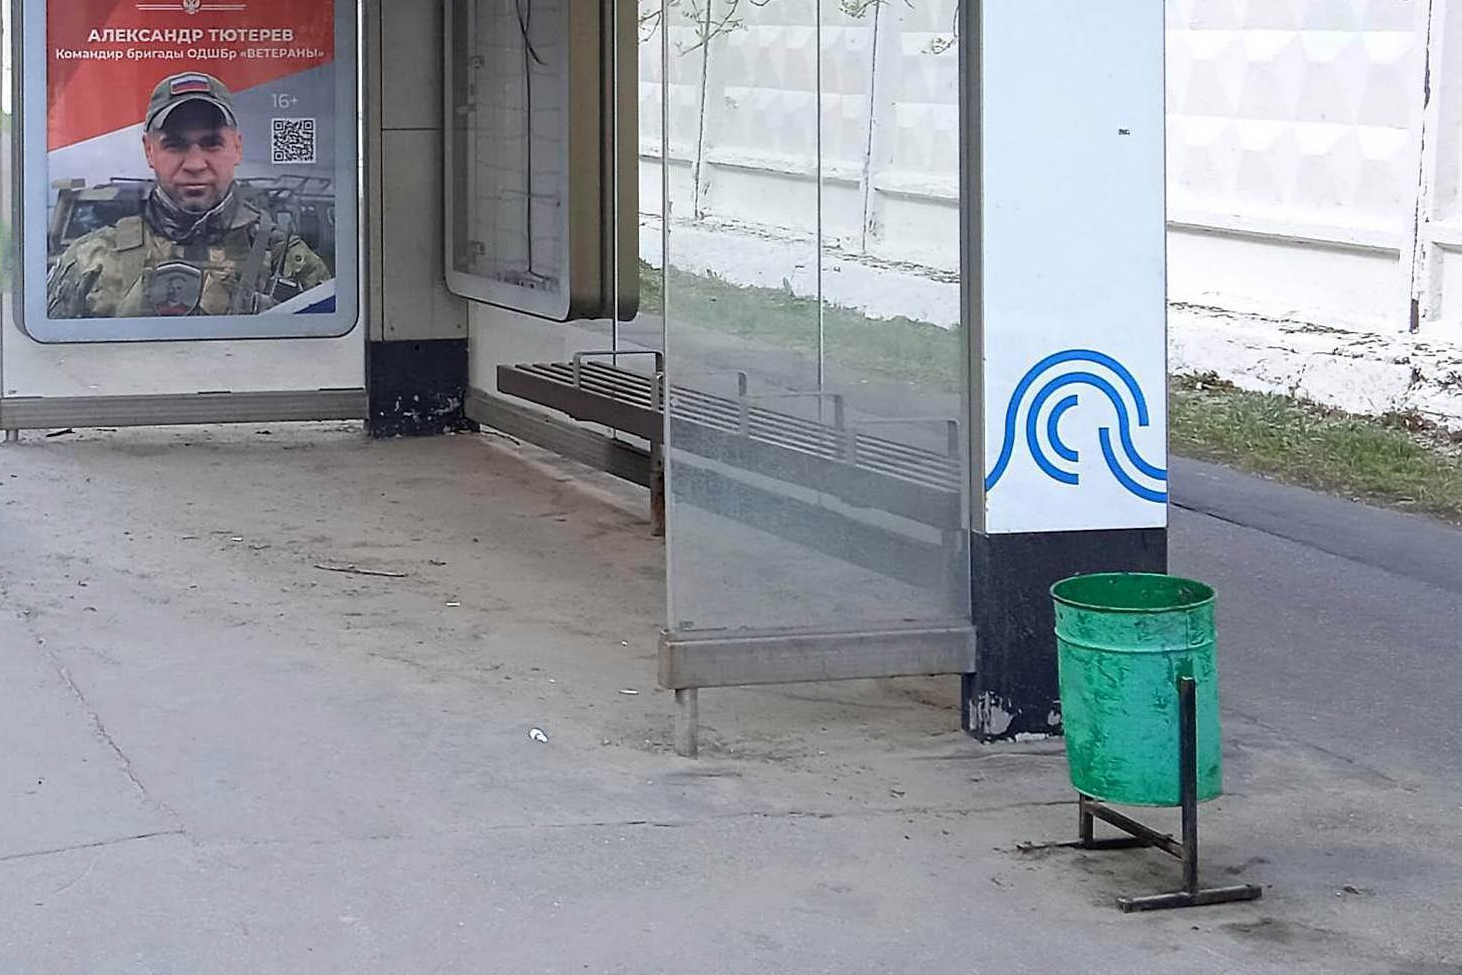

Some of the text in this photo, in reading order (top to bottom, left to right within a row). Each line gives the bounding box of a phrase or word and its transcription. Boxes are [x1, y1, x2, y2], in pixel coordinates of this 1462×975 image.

[87, 28, 294, 44] АЛЕКСАНДР ТЮТЕРЕВ
[55, 48, 325, 61] Командир бригады ОДШБр «ВЕТЕРАНЫ»
[271, 93, 299, 108] 16+
